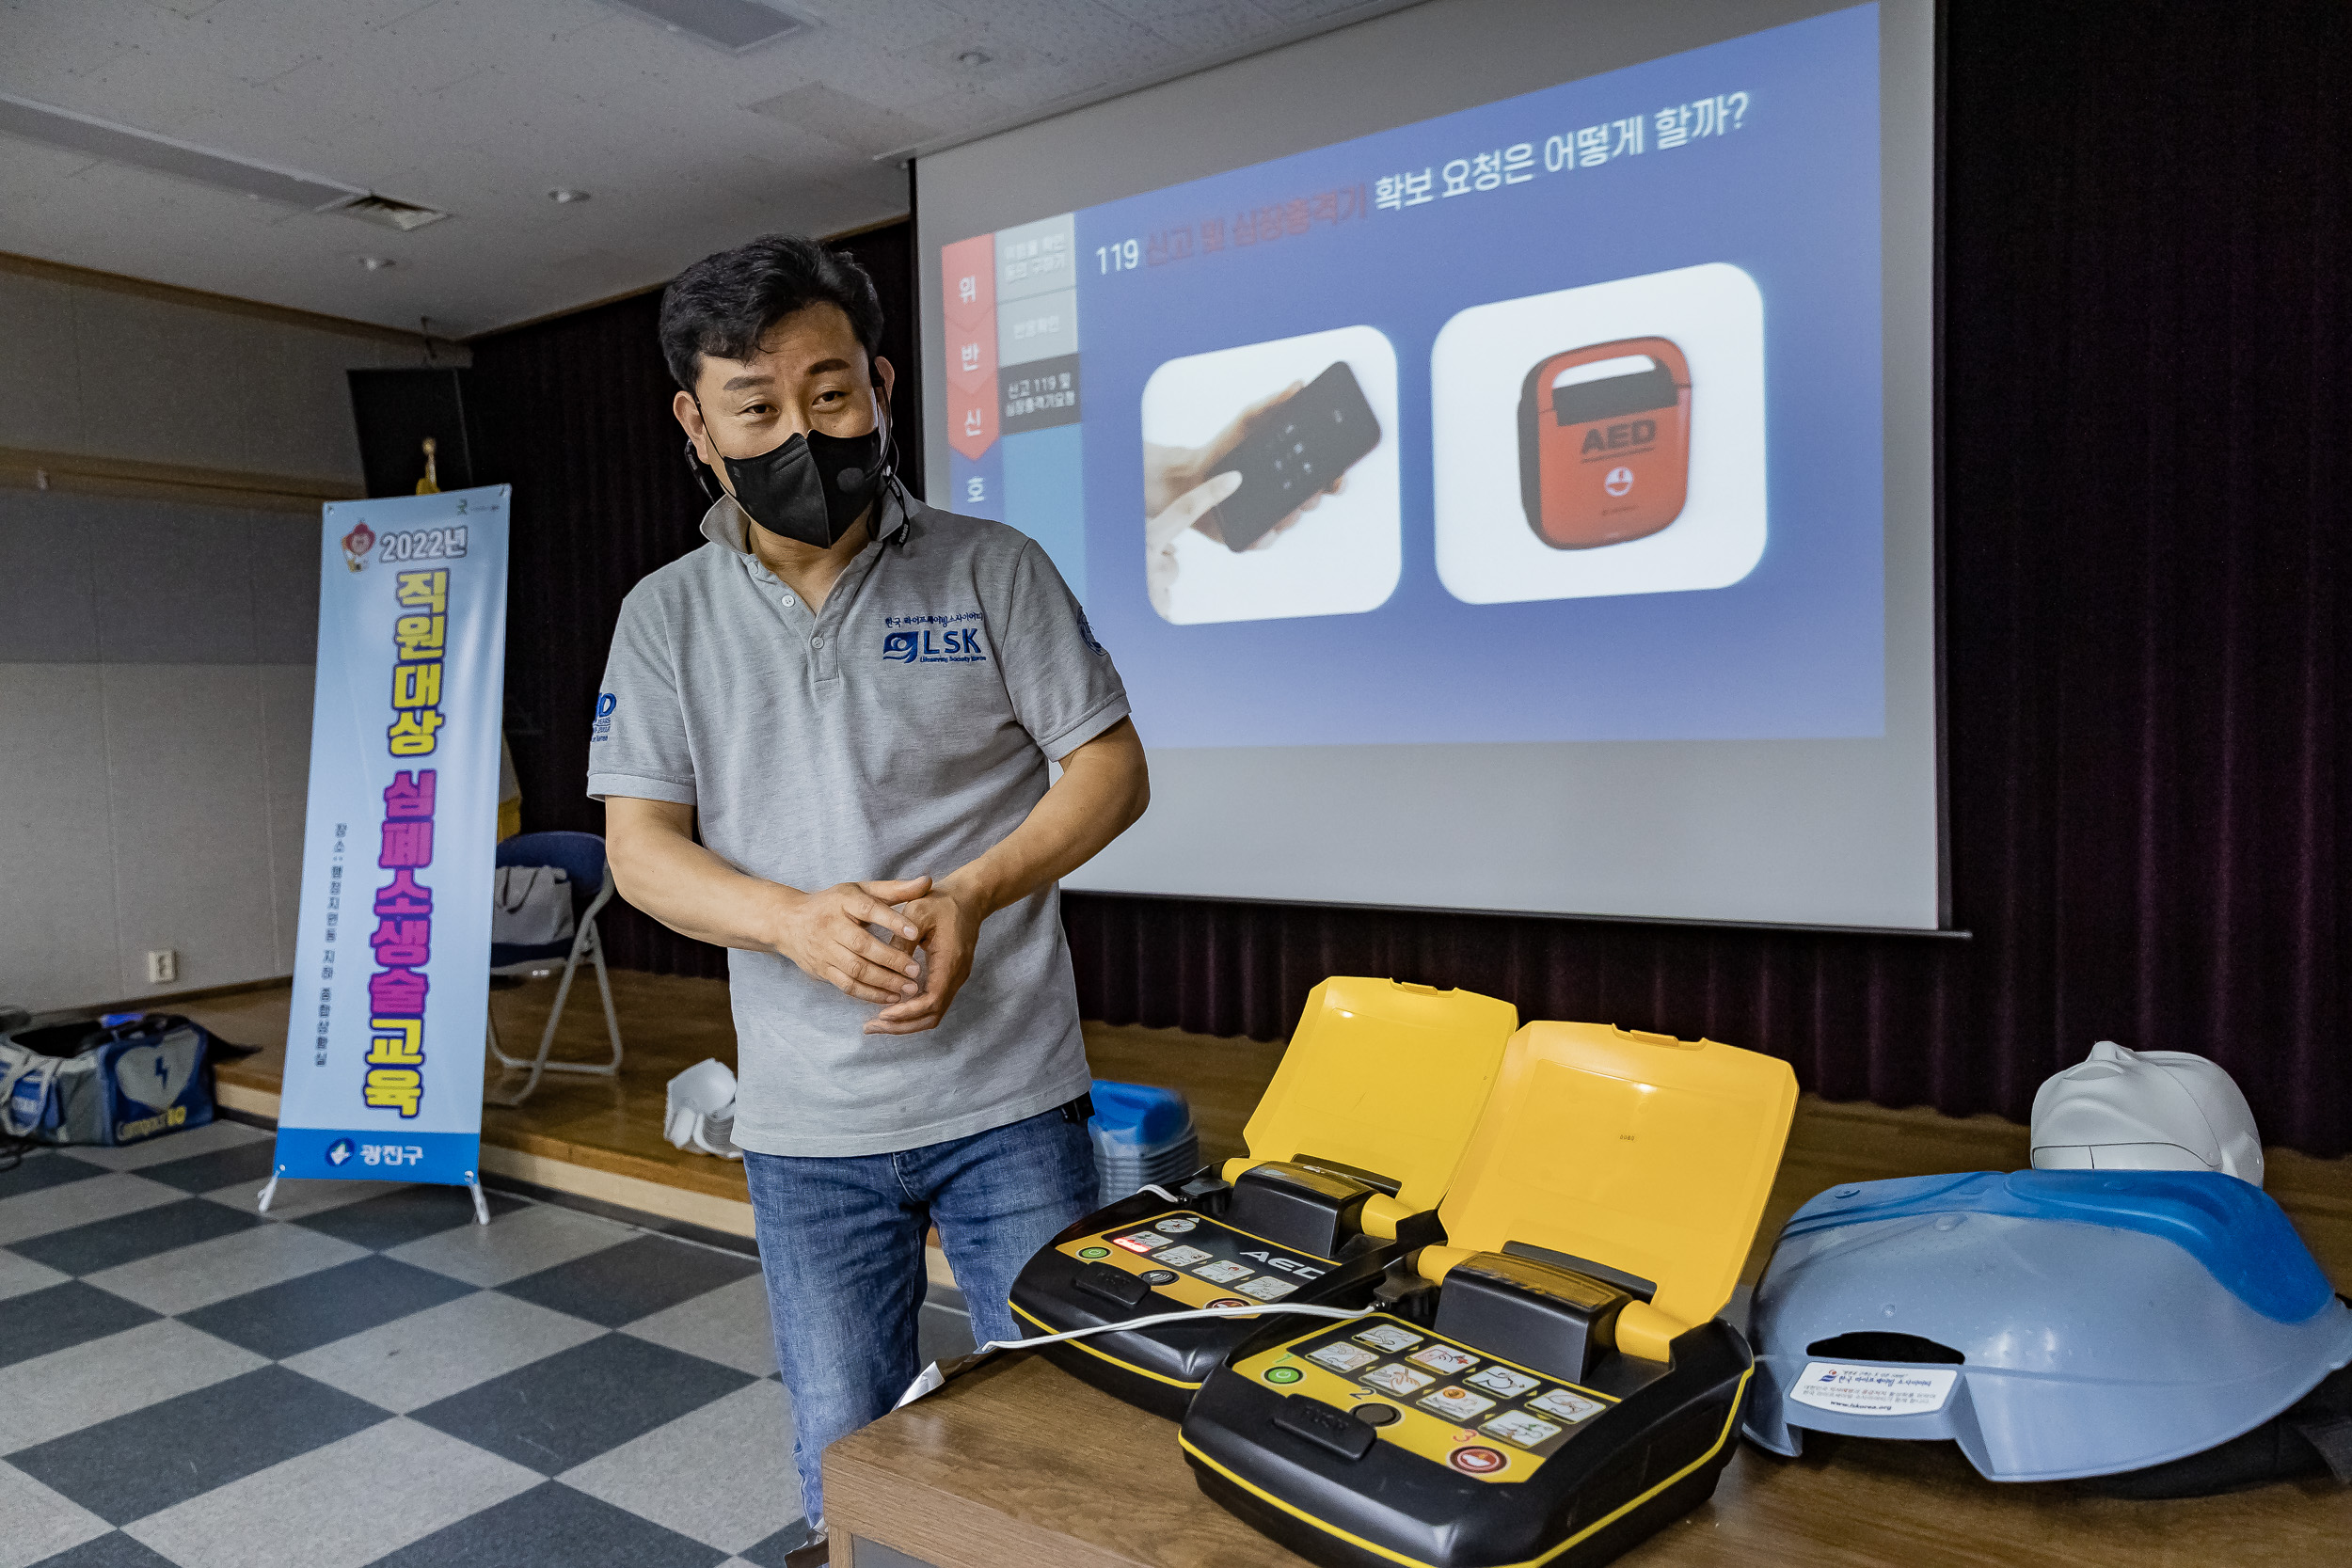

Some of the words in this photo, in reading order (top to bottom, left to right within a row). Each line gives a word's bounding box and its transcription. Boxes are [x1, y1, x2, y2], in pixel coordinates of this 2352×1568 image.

[1096, 238, 1139, 276] 119
[1148, 225, 1193, 267] 신고
[1200, 217, 1224, 254] 및
[1234, 183, 1367, 247] 심장충격기
[1375, 167, 1434, 211] 확보
[1442, 142, 1535, 198] 요청은
[1545, 115, 1644, 172] 어떻게
[1654, 91, 1750, 150] 할까?
[959, 276, 977, 305] 위
[961, 342, 980, 372] 반
[964, 408, 982, 436] 신
[1581, 420, 1657, 455] AED
[378, 525, 469, 563] 2022년
[885, 616, 901, 628] 한국
[924, 628, 982, 654] LSK
[387, 568, 449, 757] 직원대상
[363, 769, 437, 1119] 심폐소생술교육
[359, 1144, 423, 1165] 광진구
[1348, 1387, 1375, 1400] 2
[1453, 1429, 1478, 1442] 3
